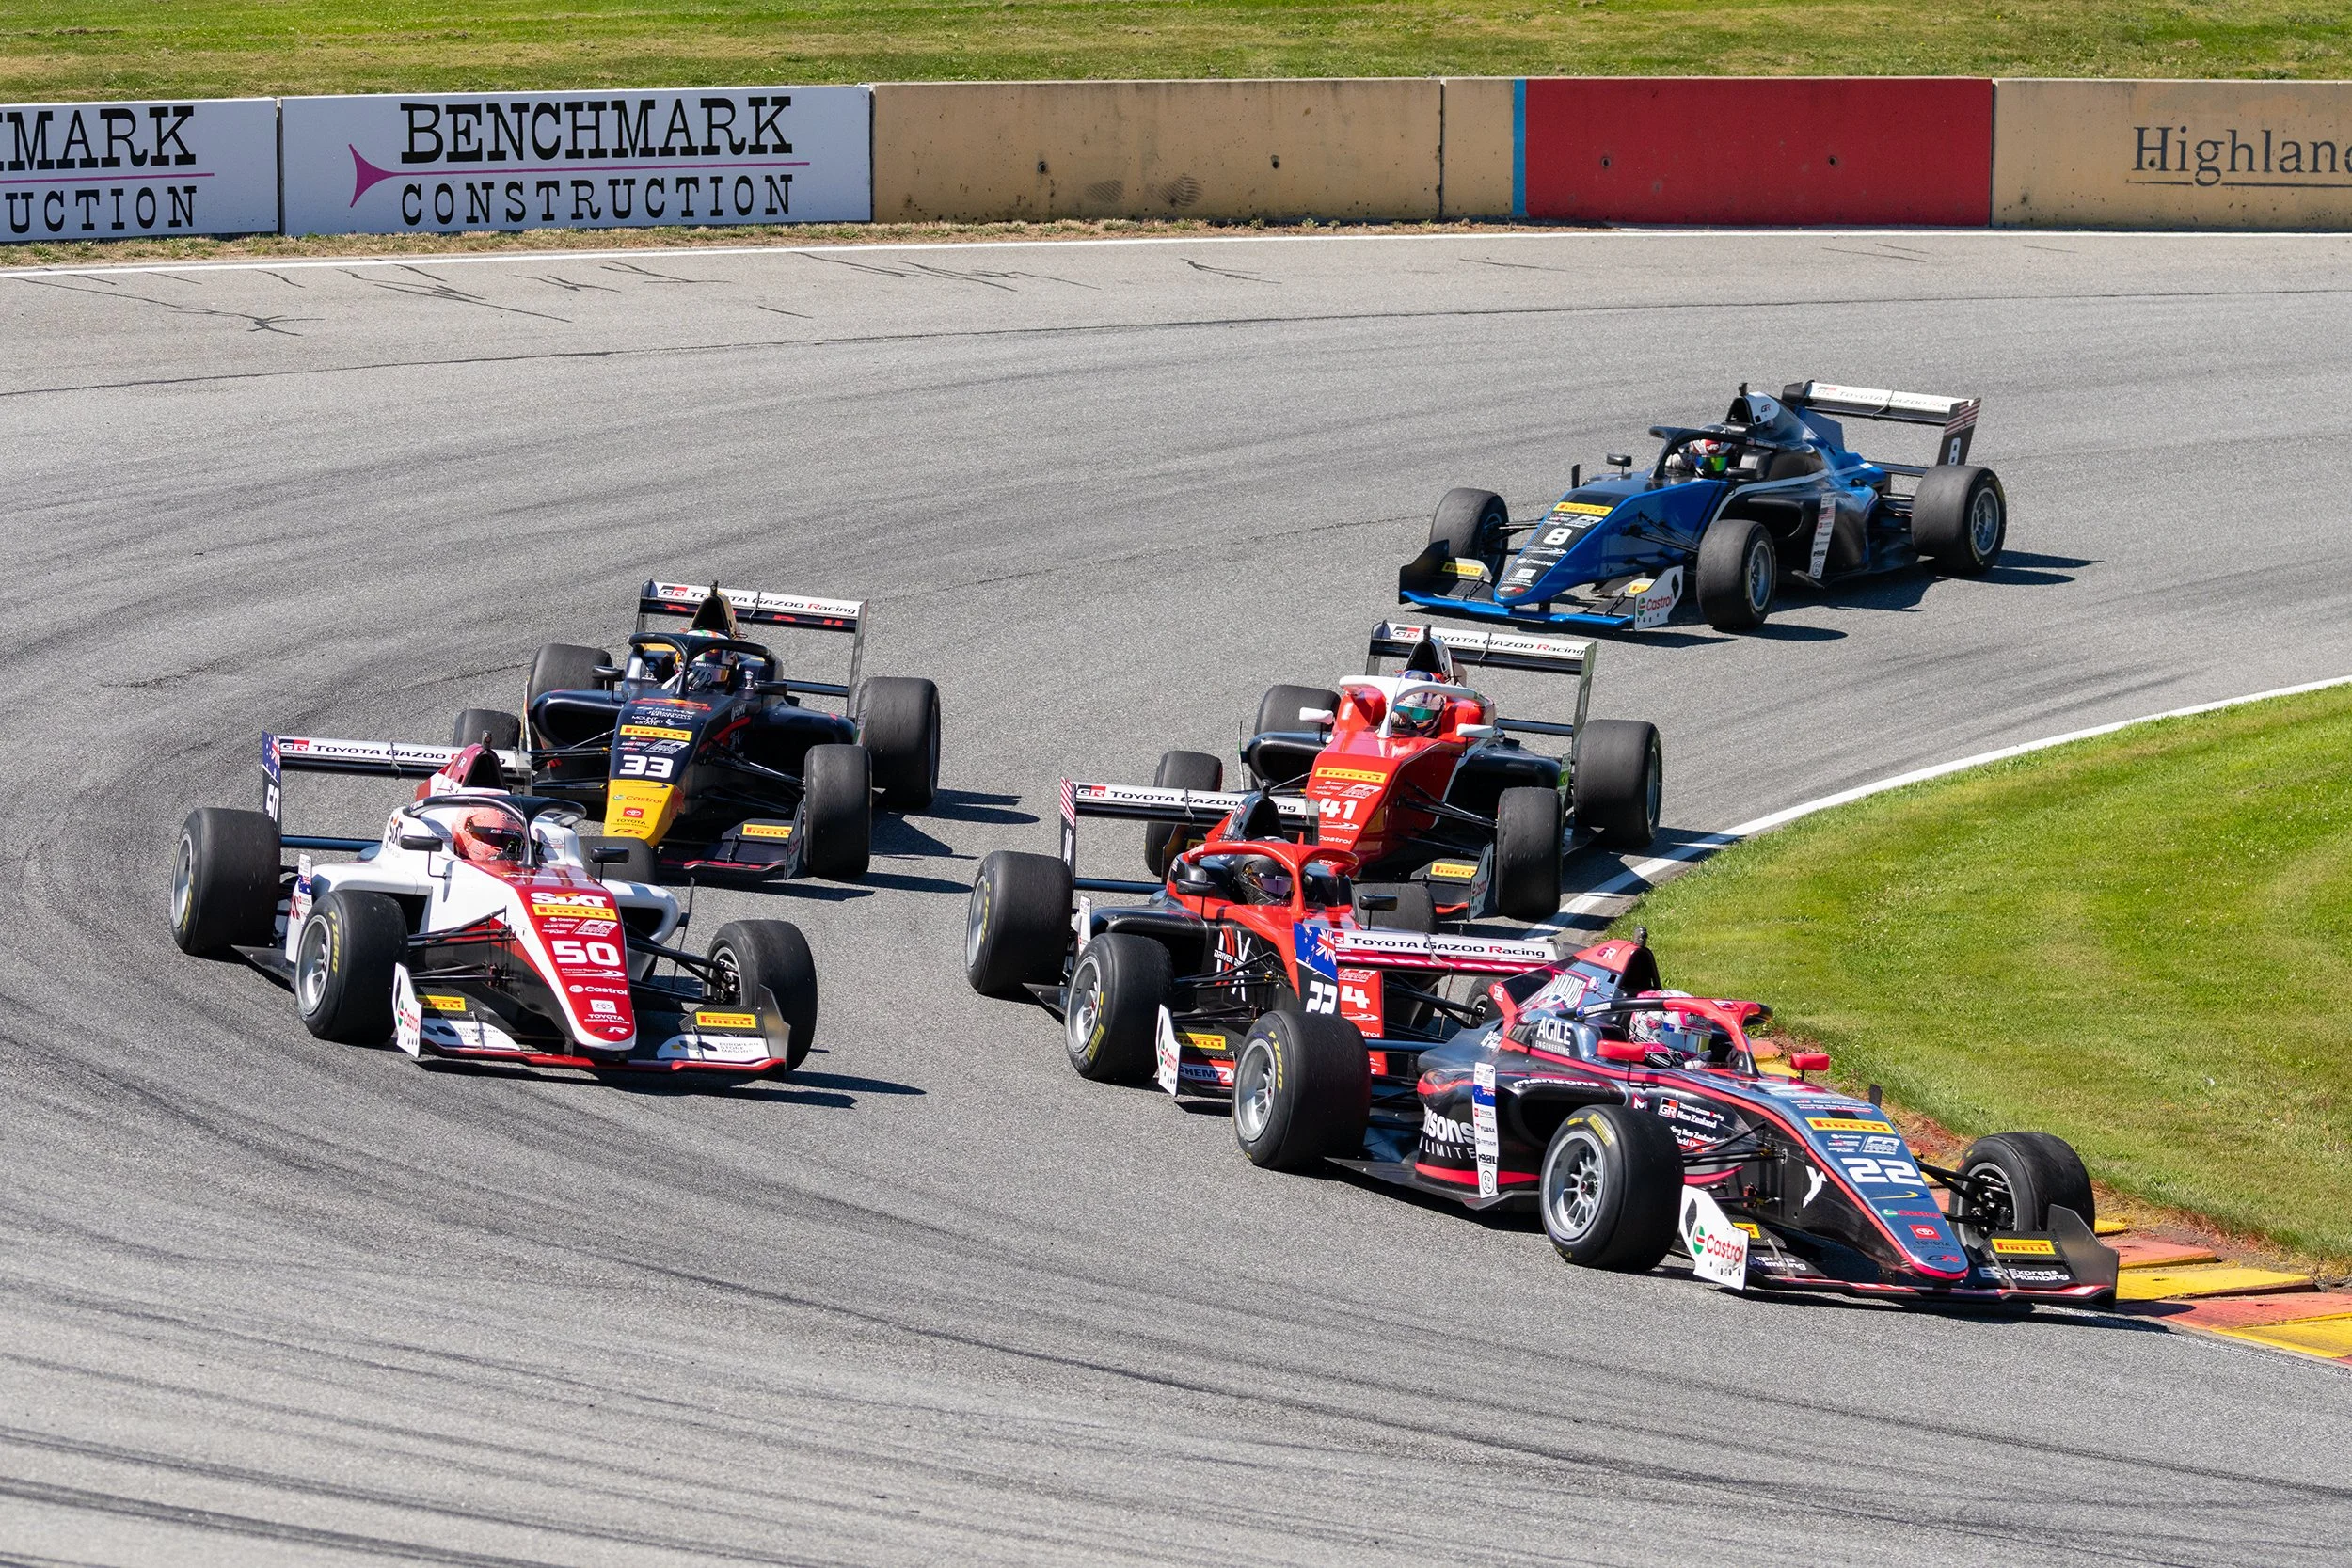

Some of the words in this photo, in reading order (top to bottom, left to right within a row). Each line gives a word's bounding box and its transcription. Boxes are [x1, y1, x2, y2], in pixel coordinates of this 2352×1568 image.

[0, 105, 196, 171] MARK
[401, 97, 792, 163] BENCHMARK
[2132, 126, 2352, 186] Highlan
[403, 174, 792, 225] CONSTRUCTION
[5, 186, 197, 233] UCTION
[1948, 437, 1961, 465] 8
[1543, 528, 1572, 545] 8
[660, 589, 685, 597] GR
[691, 591, 748, 603] TOTA
[753, 597, 803, 608] GAZOO
[807, 603, 856, 614] Racing
[1646, 594, 1673, 610] Castrol
[1482, 639, 1534, 649] GAZOO
[1537, 643, 1584, 656] Racing
[625, 728, 687, 738] PIRELLI
[281, 742, 309, 752] GR
[314, 744, 380, 756] TOYOTA
[386, 750, 446, 761] GAZOO
[619, 755, 674, 778] 33
[1321, 769, 1381, 780] PIRELLI
[266, 784, 280, 822] 50
[626, 795, 663, 804] Castrol
[1077, 788, 1104, 797] GR
[1110, 790, 1175, 801] TOYOTA
[1180, 796, 1238, 806] GAZOO
[1319, 798, 1358, 820] 41
[539, 907, 611, 917] PIRELLI
[551, 941, 621, 967] 50
[1350, 937, 1418, 948] TOYOTA
[1423, 942, 1484, 953] GAZOO
[1489, 946, 1545, 958] Racing
[1597, 947, 1617, 960] GR
[1214, 949, 1233, 964] DRIVEN
[585, 986, 628, 996] Castrol
[588, 1013, 625, 1022] TOYOTA
[700, 1016, 752, 1026] PIRELLI
[1537, 1017, 1573, 1046] AGILE
[1535, 1040, 1570, 1055] ENGINEERING
[1273, 1040, 1283, 1092] ZERO
[1513, 1078, 1599, 1087] mansons
[1660, 1105, 1676, 1117] GR
[1691, 1114, 1717, 1129] Zealand
[1813, 1119, 1887, 1132] PIRELLI
[1841, 1158, 1925, 1187] 22
[1707, 1234, 1744, 1263] Castrol
[1997, 1242, 2049, 1252] PIRELLI
